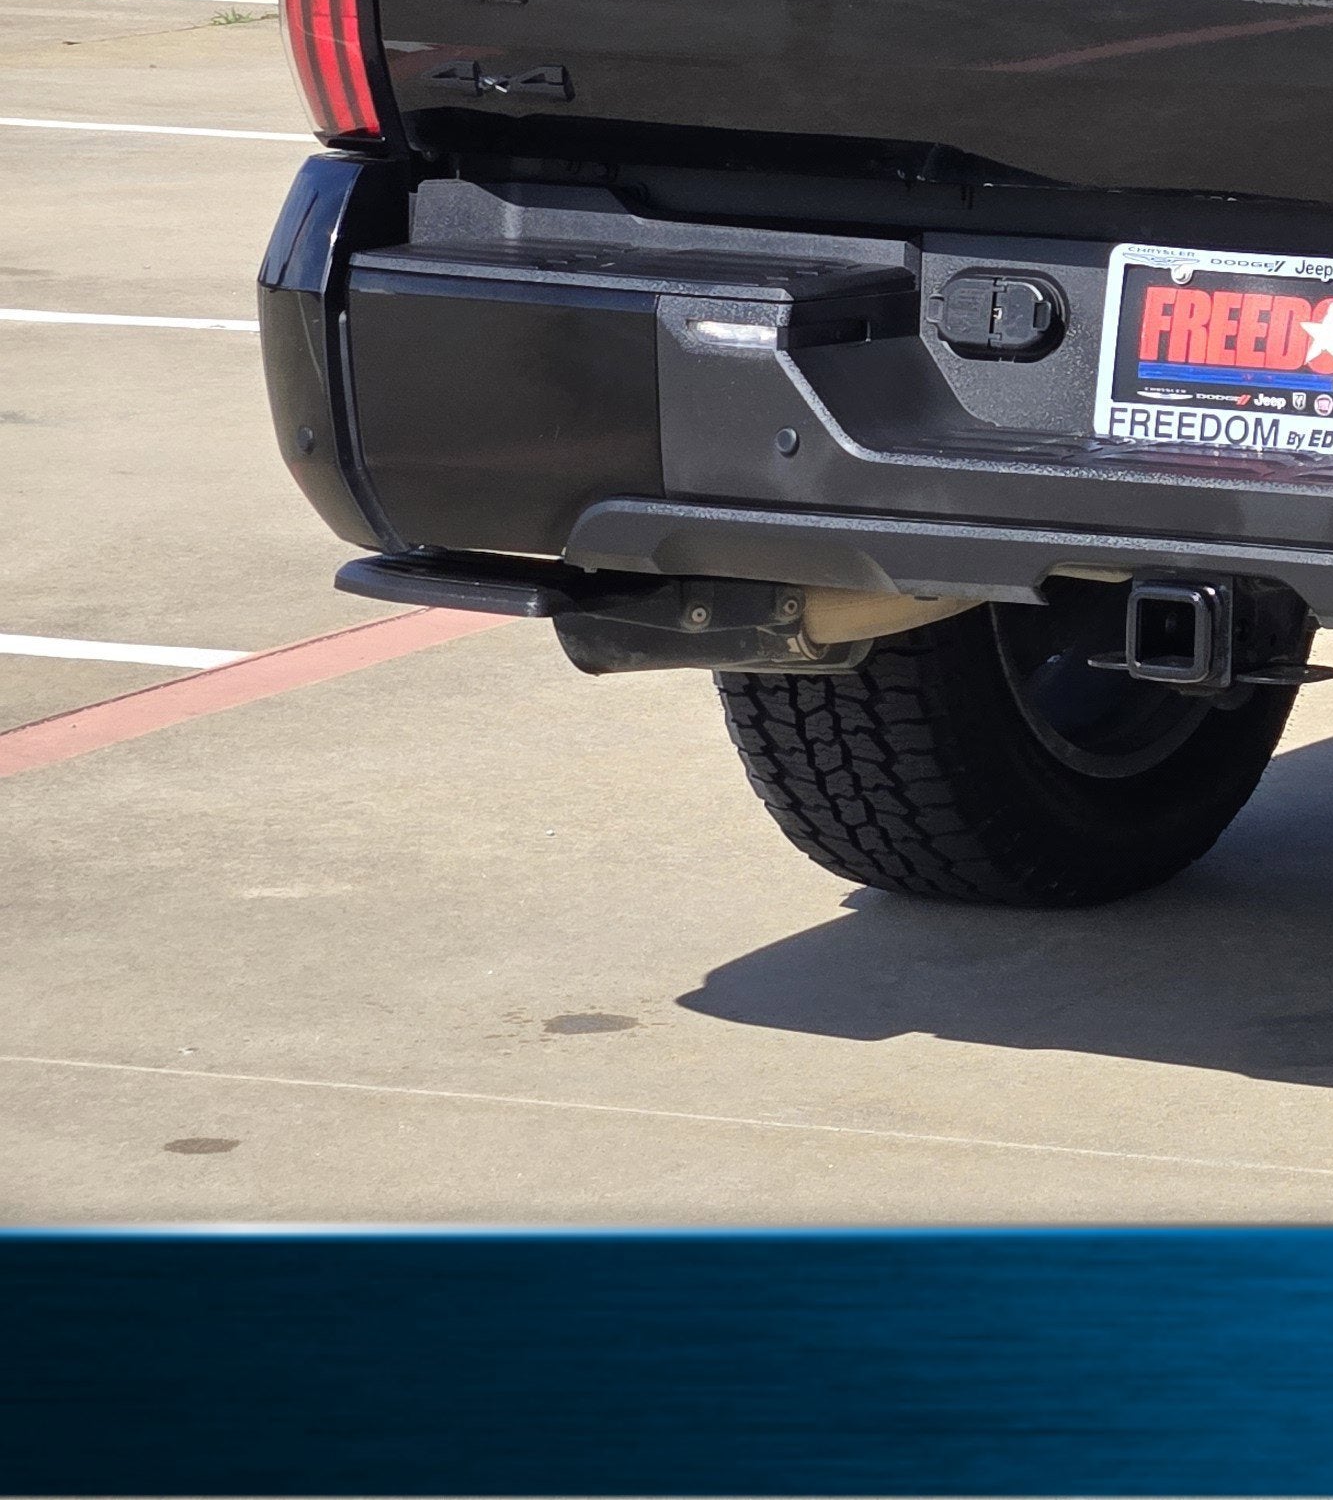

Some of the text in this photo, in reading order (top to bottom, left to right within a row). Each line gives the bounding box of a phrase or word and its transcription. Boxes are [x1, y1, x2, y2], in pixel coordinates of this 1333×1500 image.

[1128, 246, 1196, 258] CHRYSLER
[1210, 258, 1275, 269] DODGE
[1295, 260, 1333, 278] Jeep
[1253, 393, 1287, 409] Jeep
[1108, 406, 1280, 447] FREEDOM
